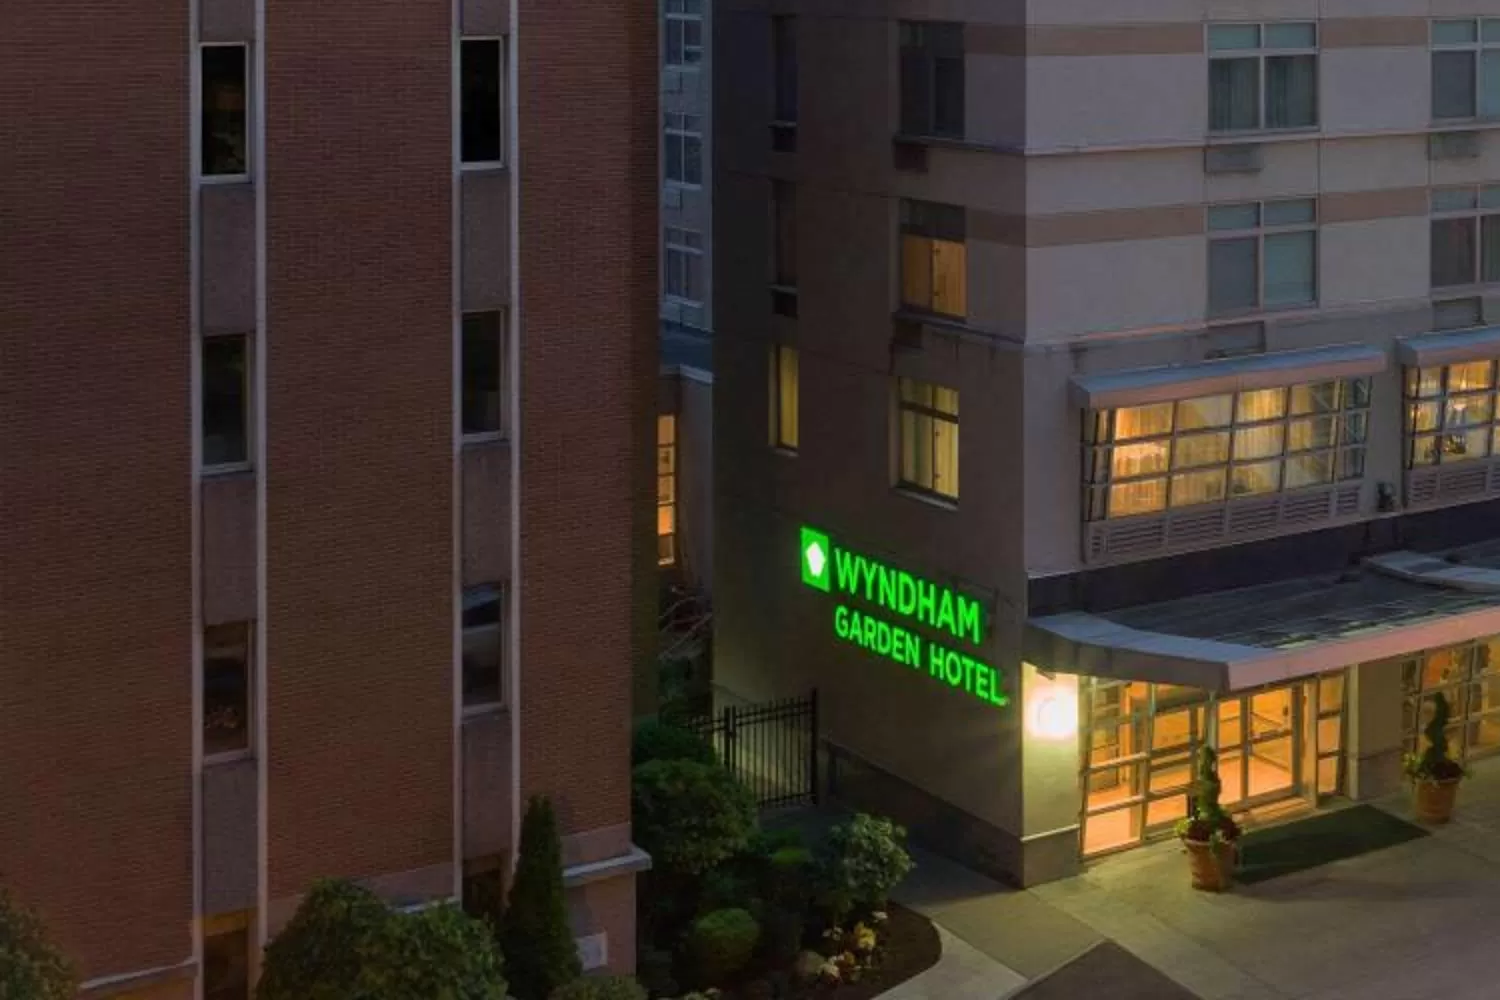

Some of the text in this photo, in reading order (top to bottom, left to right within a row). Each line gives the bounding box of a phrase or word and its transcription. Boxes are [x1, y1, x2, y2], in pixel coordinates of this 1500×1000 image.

[834, 547, 981, 644] WYNDHAM
[834, 605, 1008, 706] GARDEN HOTEL
